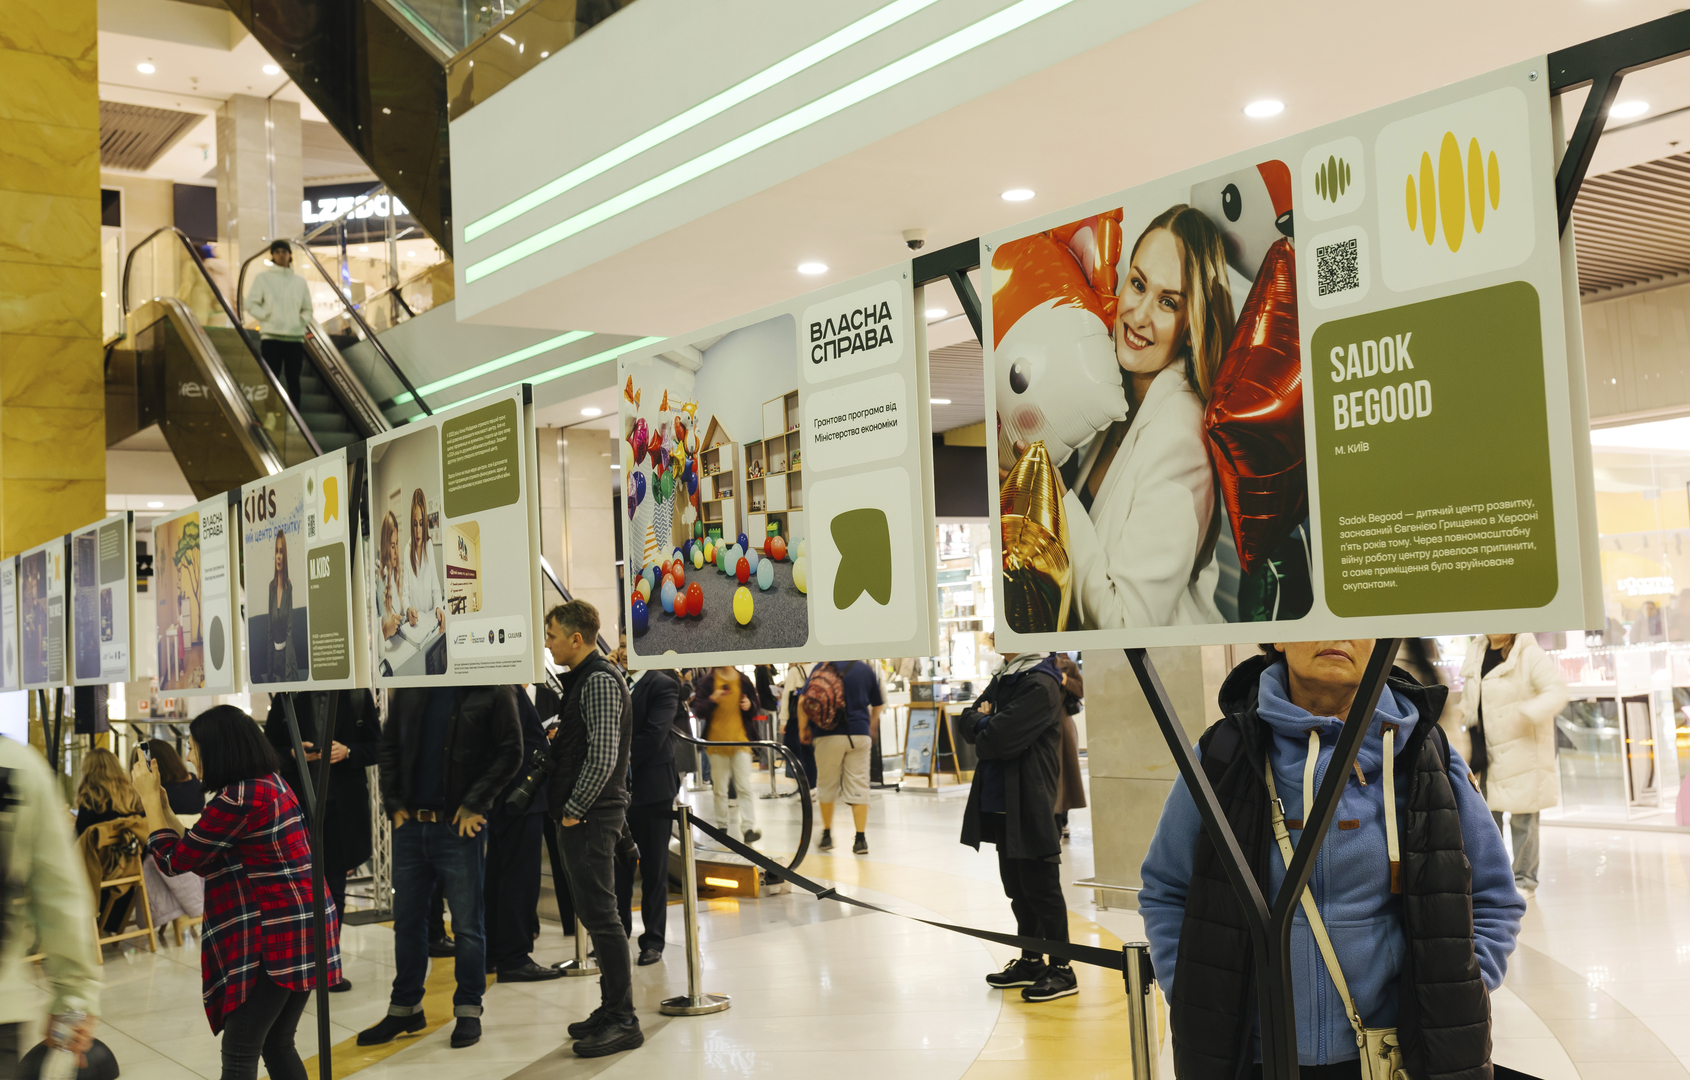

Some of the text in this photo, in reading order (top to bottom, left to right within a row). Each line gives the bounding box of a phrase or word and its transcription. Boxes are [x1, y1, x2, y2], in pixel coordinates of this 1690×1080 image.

[810, 301, 893, 343] ВЛАСНА
[812, 325, 894, 365] СПРАВА
[1330, 331, 1415, 383] SADOK
[814, 402, 897, 429] Грантова програма від
[1332, 379, 1433, 431] BEGOOD
[814, 418, 898, 443] Міністерства економіки
[1339, 514, 1367, 526] Sadok
[1368, 510, 1403, 523] Begood
[1415, 505, 1454, 519] дитячий
[1455, 503, 1485, 515] центр
[1486, 499, 1535, 513] розвитку,
[1339, 510, 1539, 539] заснований Євгенією Грищенко в Херсоні
[1363, 540, 1387, 552] років
[1387, 538, 1412, 549] тому.
[1413, 535, 1443, 546] Через
[1444, 526, 1531, 543] повномасштабну
[1341, 541, 1537, 566] війну роботу центру довелося припинити,
[1341, 557, 1515, 578] а саме приміщення було зруйноване
[1342, 580, 1398, 592] окупантами.
